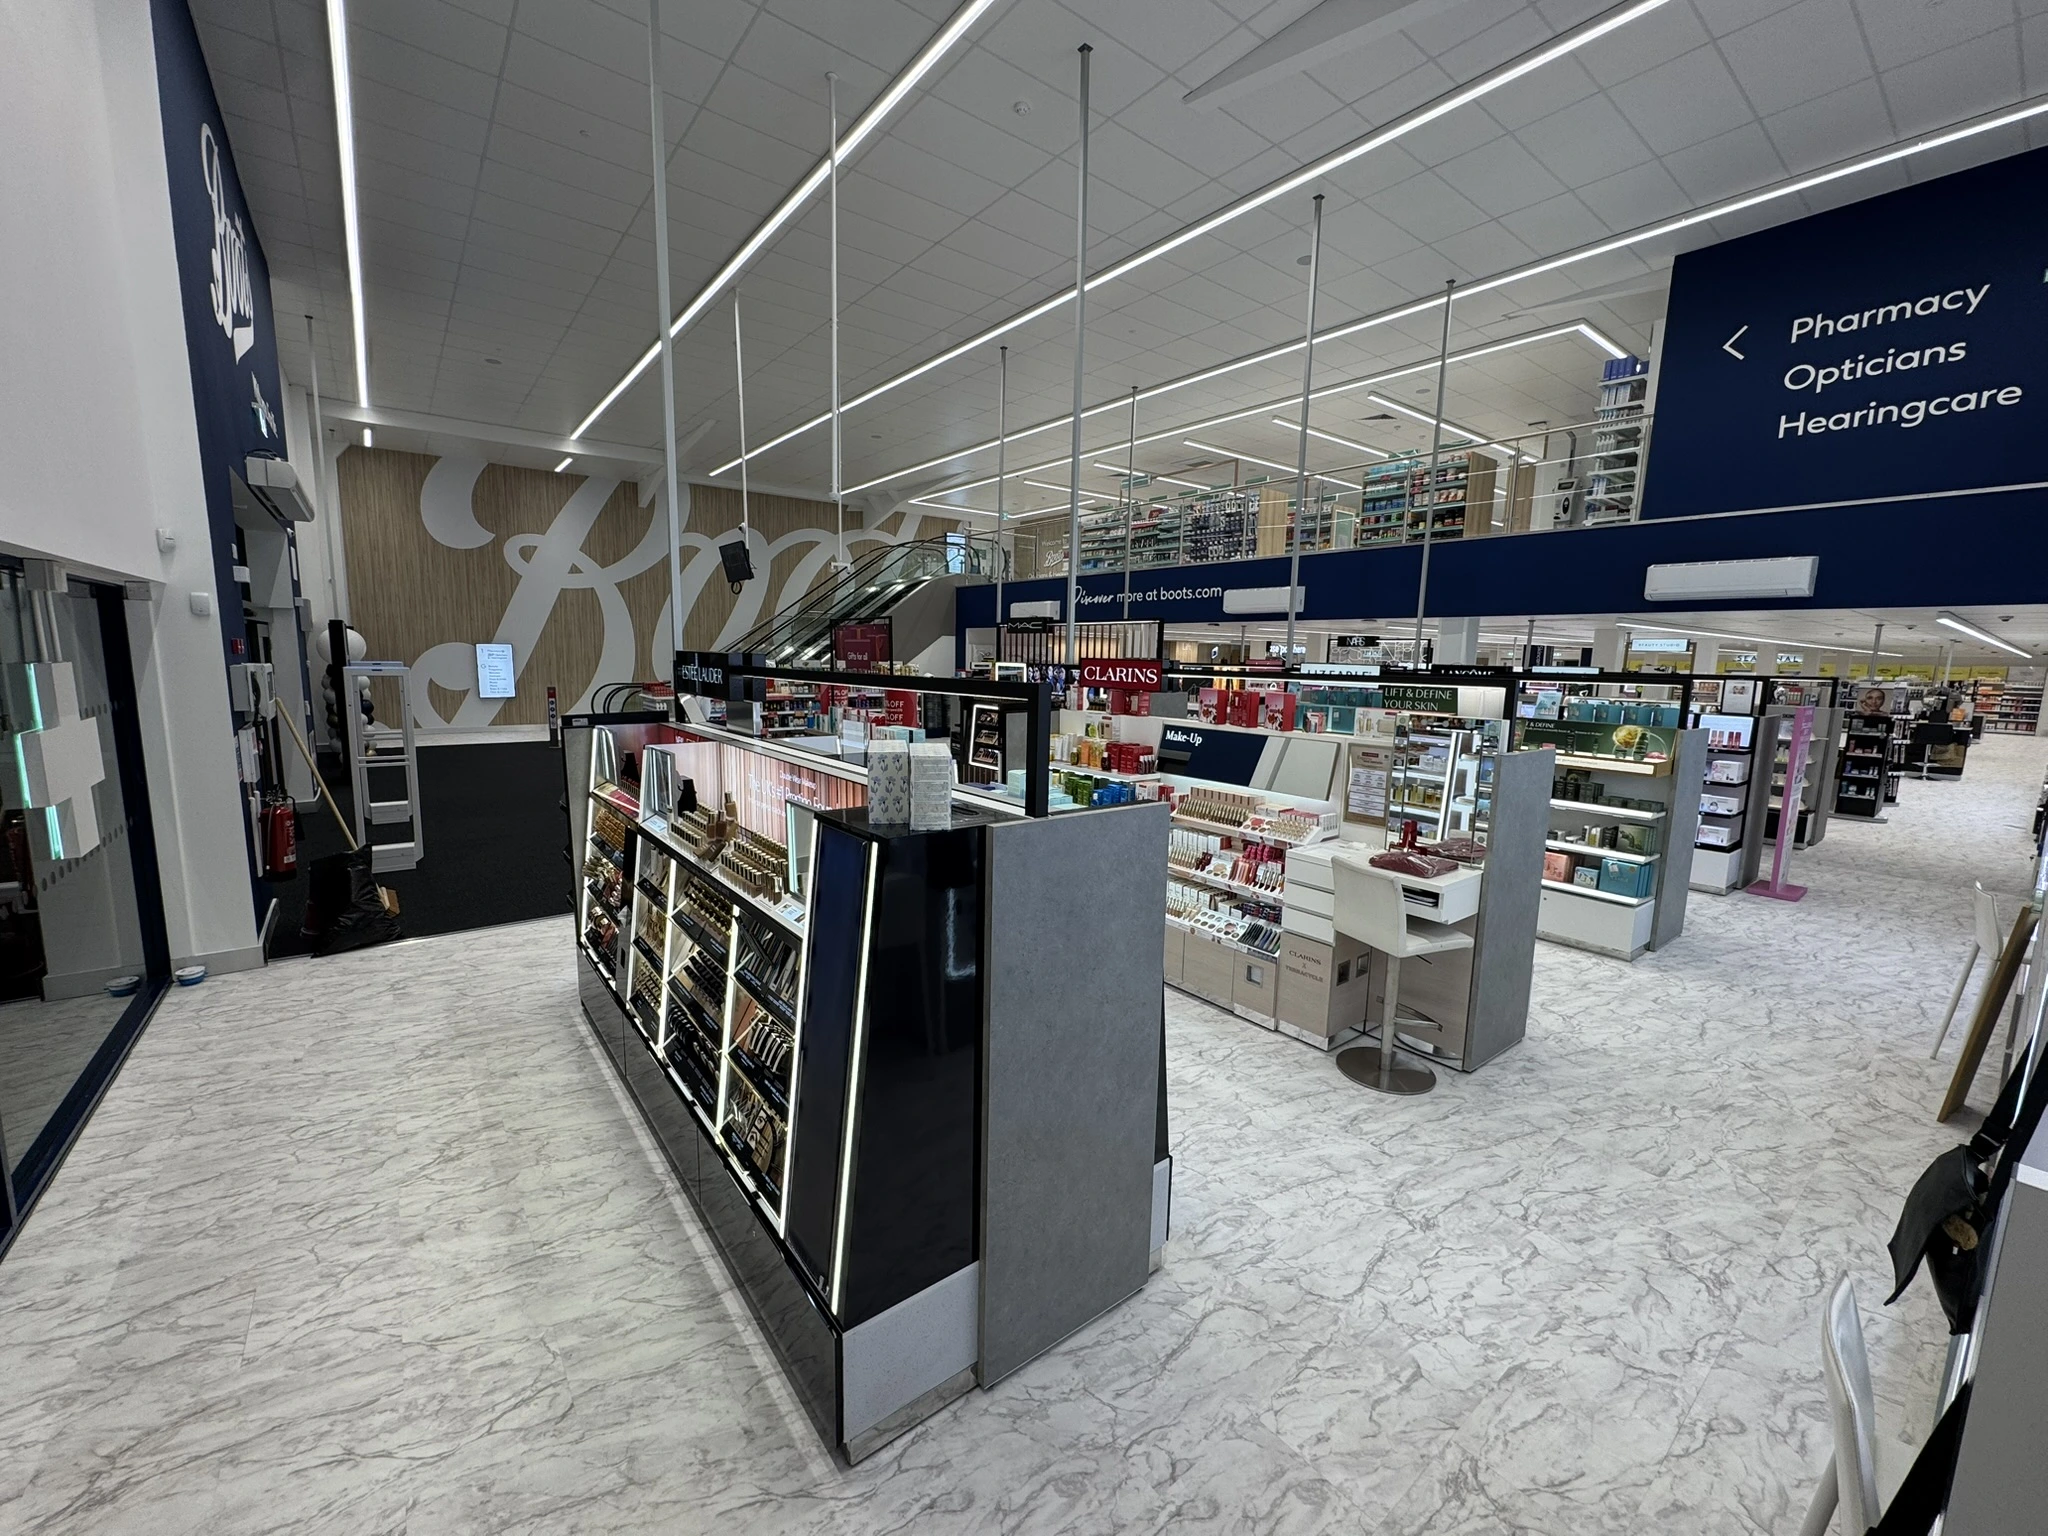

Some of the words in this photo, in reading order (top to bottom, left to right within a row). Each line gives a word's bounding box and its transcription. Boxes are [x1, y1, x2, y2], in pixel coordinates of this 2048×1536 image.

[1789, 283, 1991, 344] Pharmacy
[1783, 340, 1967, 393] Opticians
[1777, 385, 2023, 439] Hearingcare
[1074, 585, 1114, 605] Discover
[1116, 591, 1143, 602] more
[1145, 588, 1158, 601] at
[1160, 586, 1222, 600] boots.com
[1007, 621, 1043, 629] MAC
[1346, 637, 1366, 646] NARS
[681, 663, 698, 681] ESTÉE
[698, 666, 723, 684] LAUDER
[1083, 666, 1158, 684] CLARINS
[1385, 687, 1405, 697] LIFT
[1405, 688, 1414, 698] &
[1415, 689, 1453, 700] DEFINE
[1384, 699, 1413, 710] YOUR
[1414, 701, 1439, 711] SKIN
[1165, 730, 1203, 747] Make-Up
[748, 769, 761, 793] The
[762, 779, 776, 799] UK's
[1288, 950, 1322, 965] CLARINS
